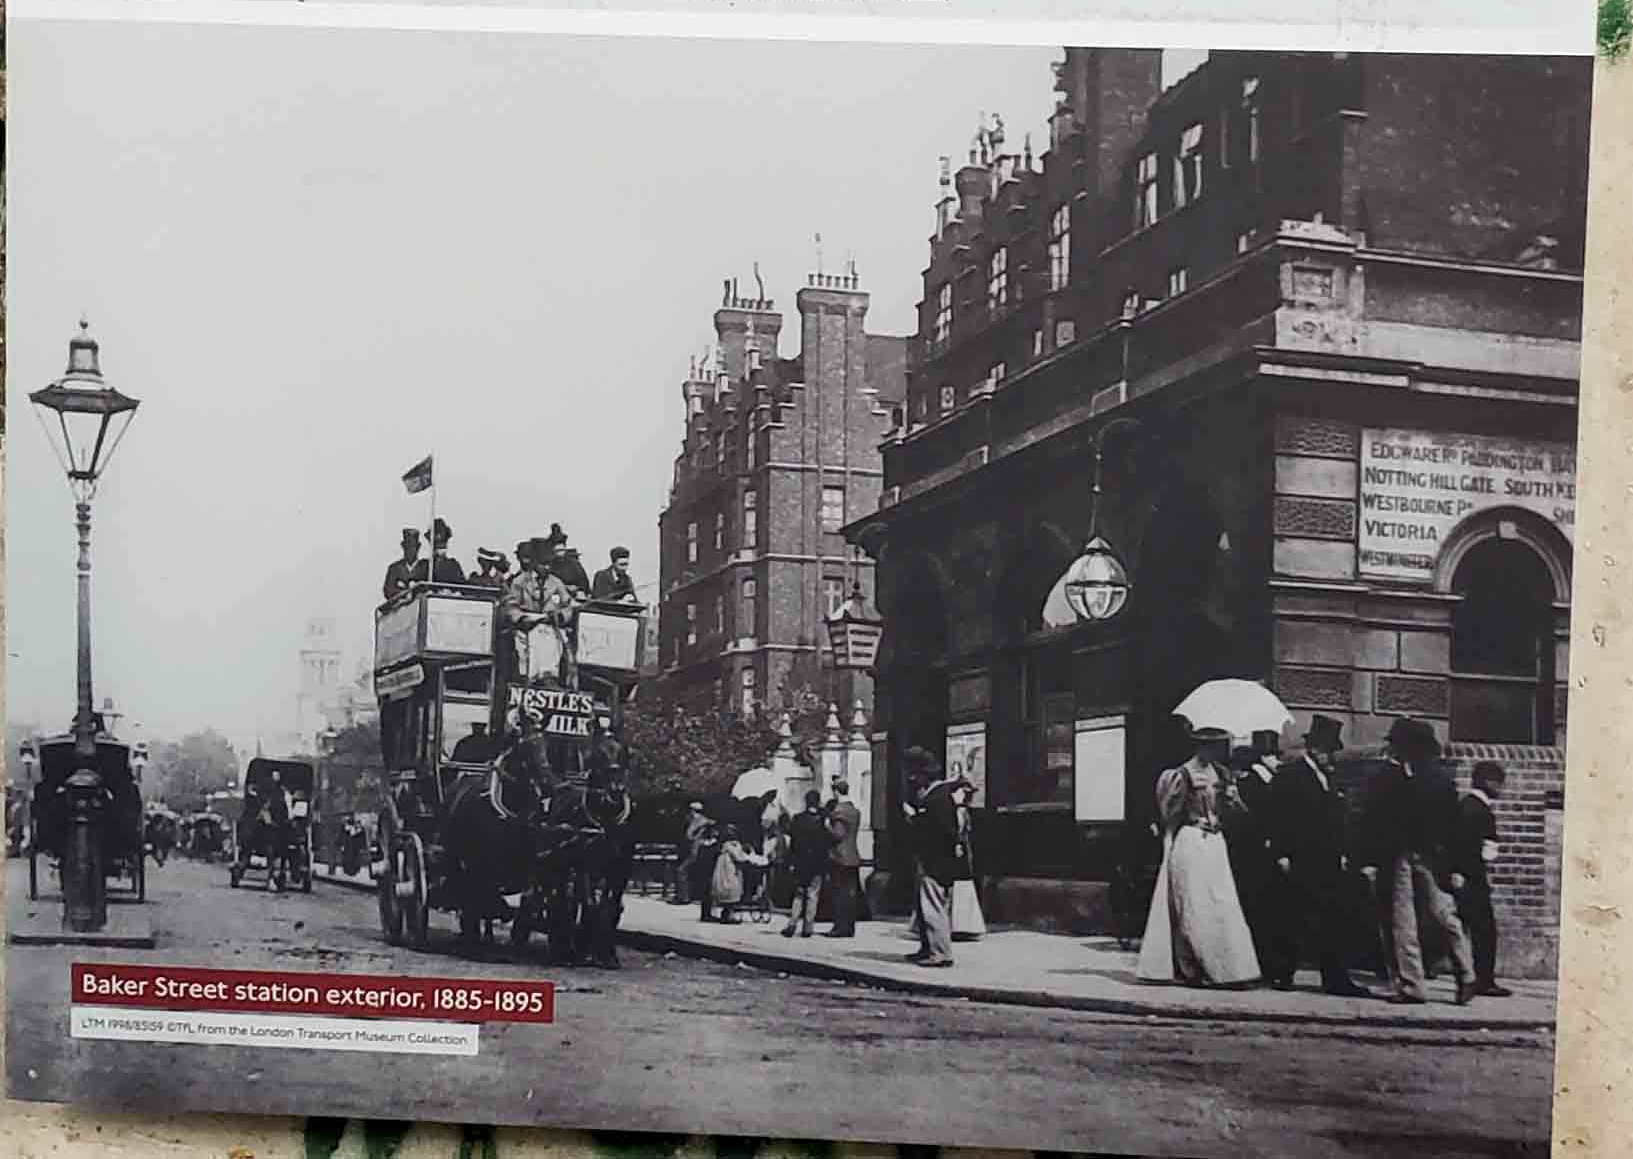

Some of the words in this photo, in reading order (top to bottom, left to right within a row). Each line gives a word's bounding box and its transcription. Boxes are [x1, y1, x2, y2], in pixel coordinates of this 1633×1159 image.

[1364, 466, 1427, 488] NOTTING
[1429, 473, 1458, 491] HILL
[1503, 478, 1554, 498] SOUTH
[1365, 520, 1438, 541] VICTORIA
[81, 973, 149, 996] Baker
[153, 976, 229, 1000] Street
[234, 982, 319, 1004] station
[325, 986, 426, 1010] exterior,
[80, 1018, 106, 1030] LTM
[197, 1023, 227, 1035] from
[228, 1025, 248, 1036] the
[250, 1026, 294, 1039] London
[297, 1027, 352, 1043] Transport
[354, 1029, 405, 1043] Museum
[407, 1032, 467, 1047] Collection
